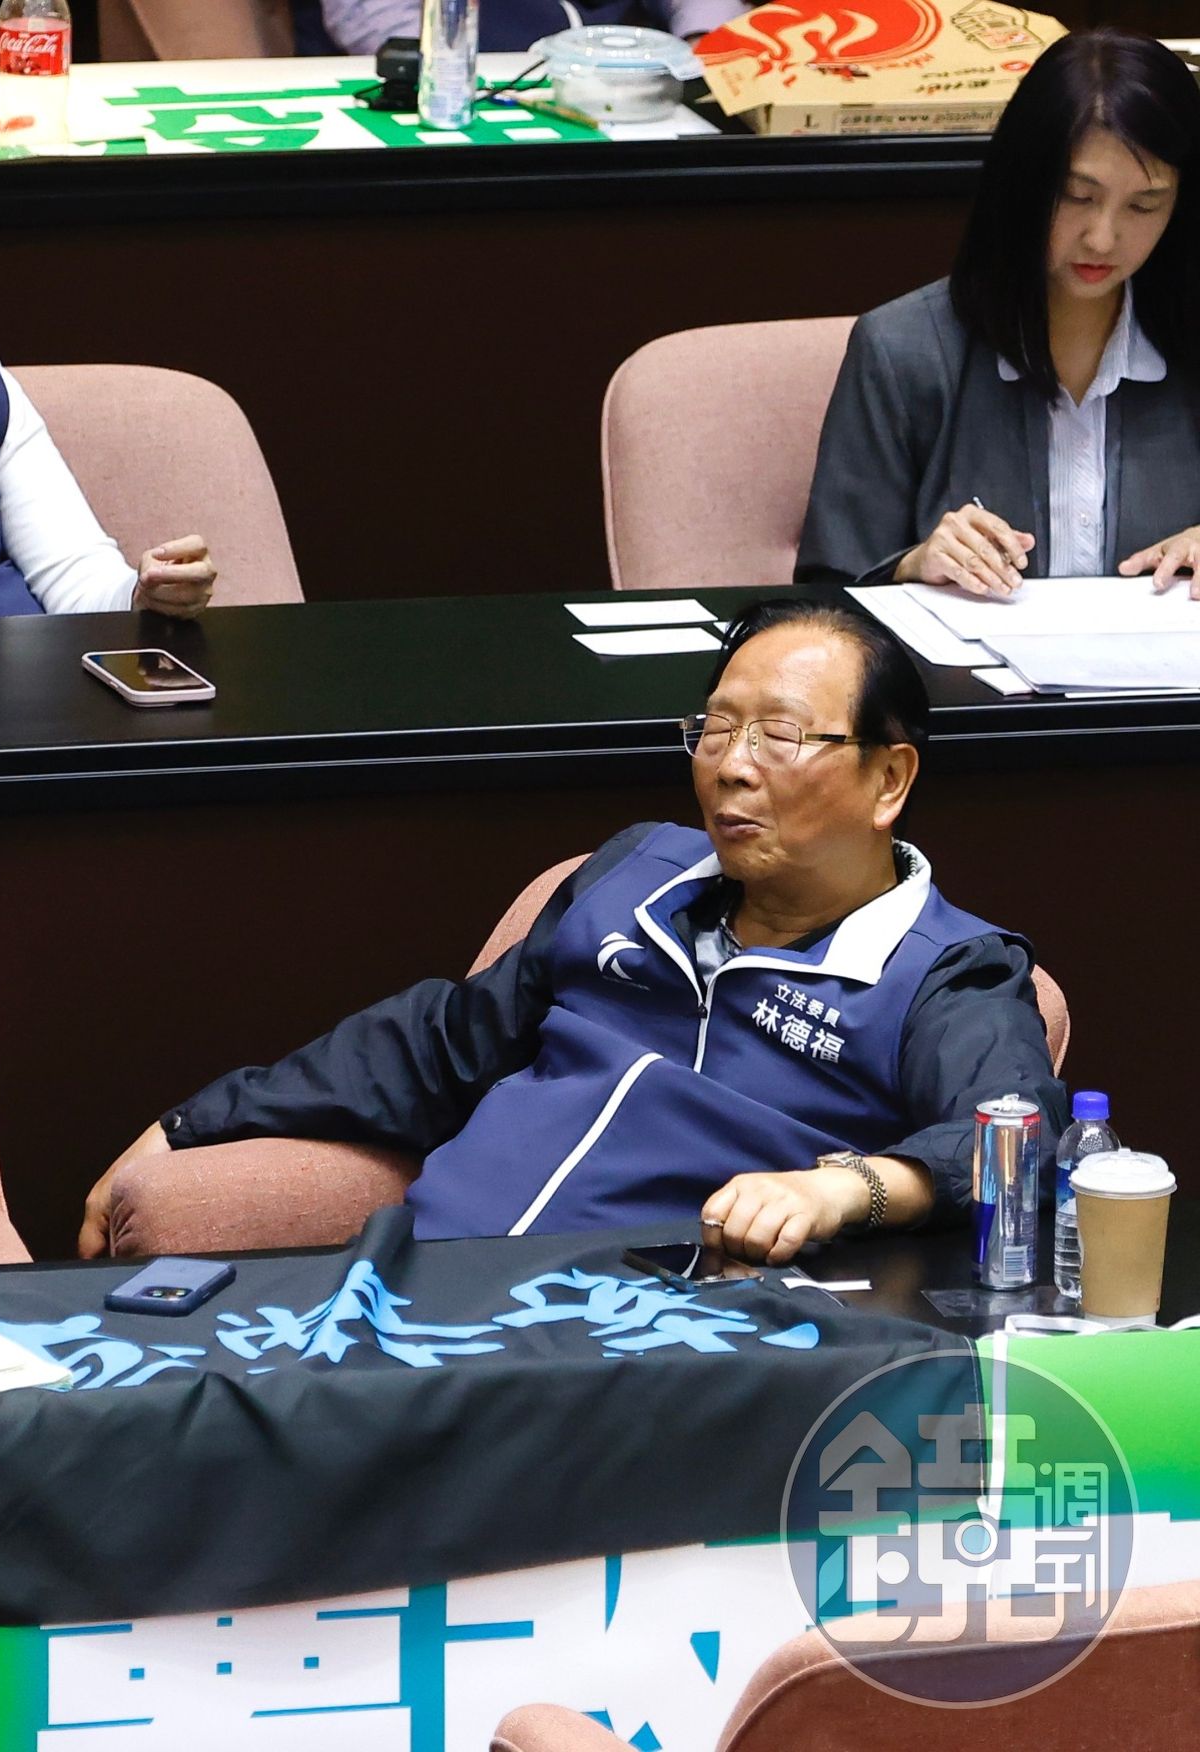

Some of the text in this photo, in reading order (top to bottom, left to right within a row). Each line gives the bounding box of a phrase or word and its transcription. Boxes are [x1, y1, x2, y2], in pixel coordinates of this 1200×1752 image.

[752, 998, 845, 1064] 林德福
[774, 983, 841, 1028] 立法委員
